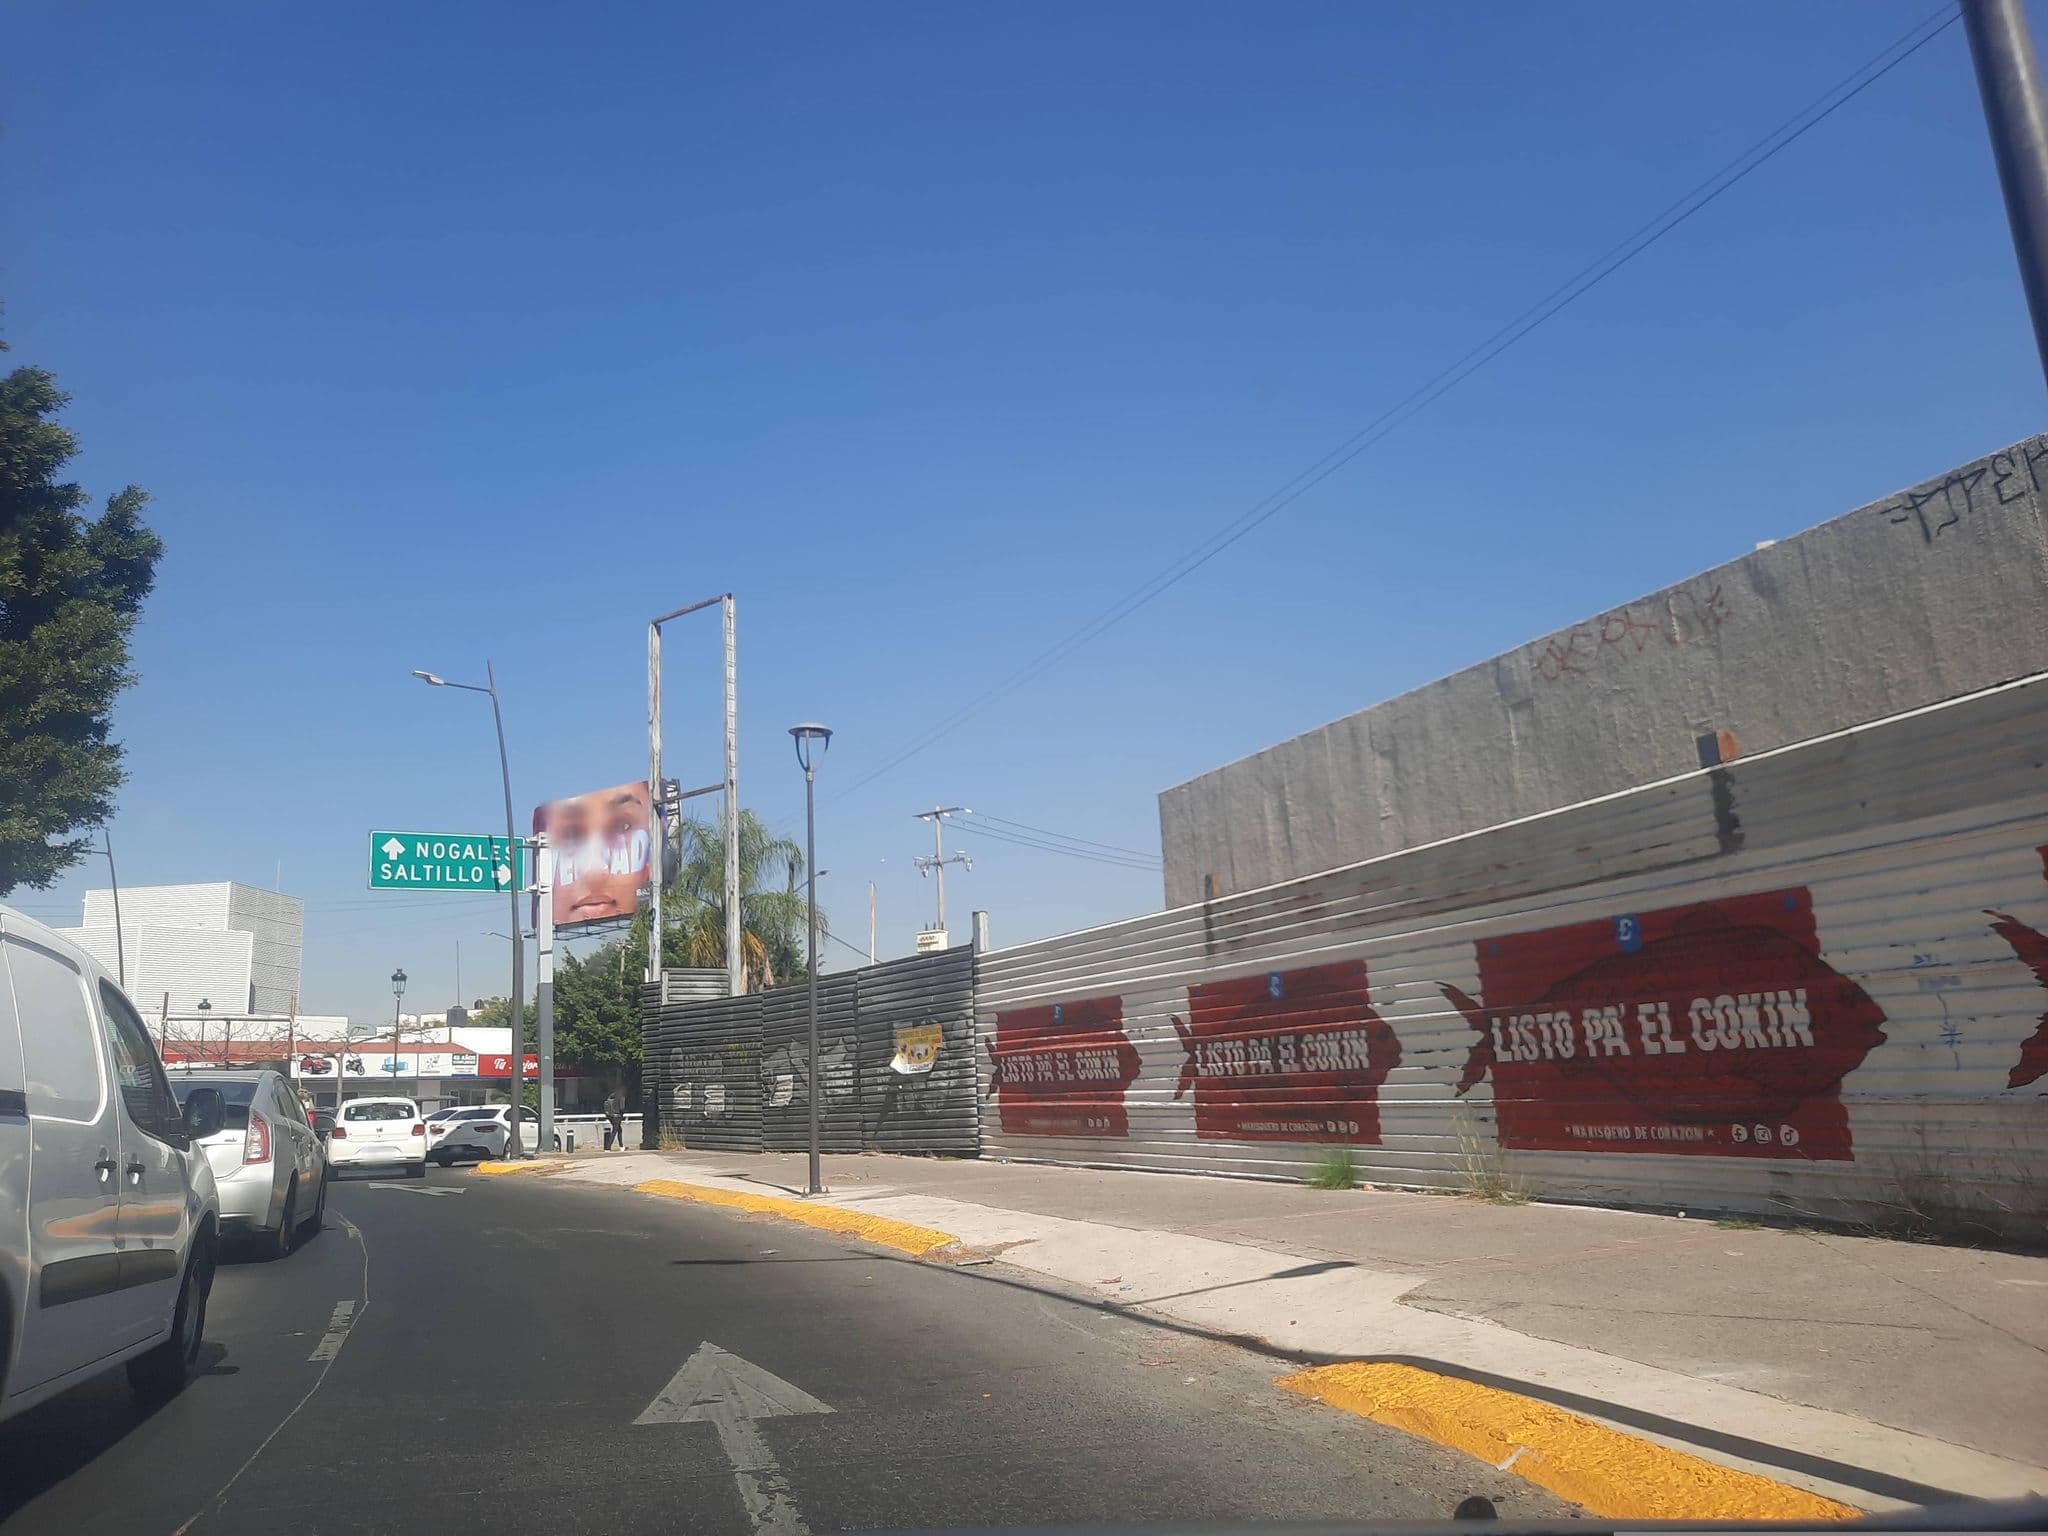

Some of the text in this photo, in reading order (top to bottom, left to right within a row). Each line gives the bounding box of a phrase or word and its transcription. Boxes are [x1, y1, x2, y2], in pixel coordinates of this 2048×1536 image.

[416, 842, 512, 861] NOGALES
[380, 864, 484, 882] SALTILLO
[1490, 988, 1815, 1062] LISTO PA' EL COKIN
[494, 1057, 507, 1070] Tu
[1195, 1040, 1245, 1076] LISTO
[1278, 1035, 1301, 1073] EL
[1634, 1126, 1648, 1139] DE
